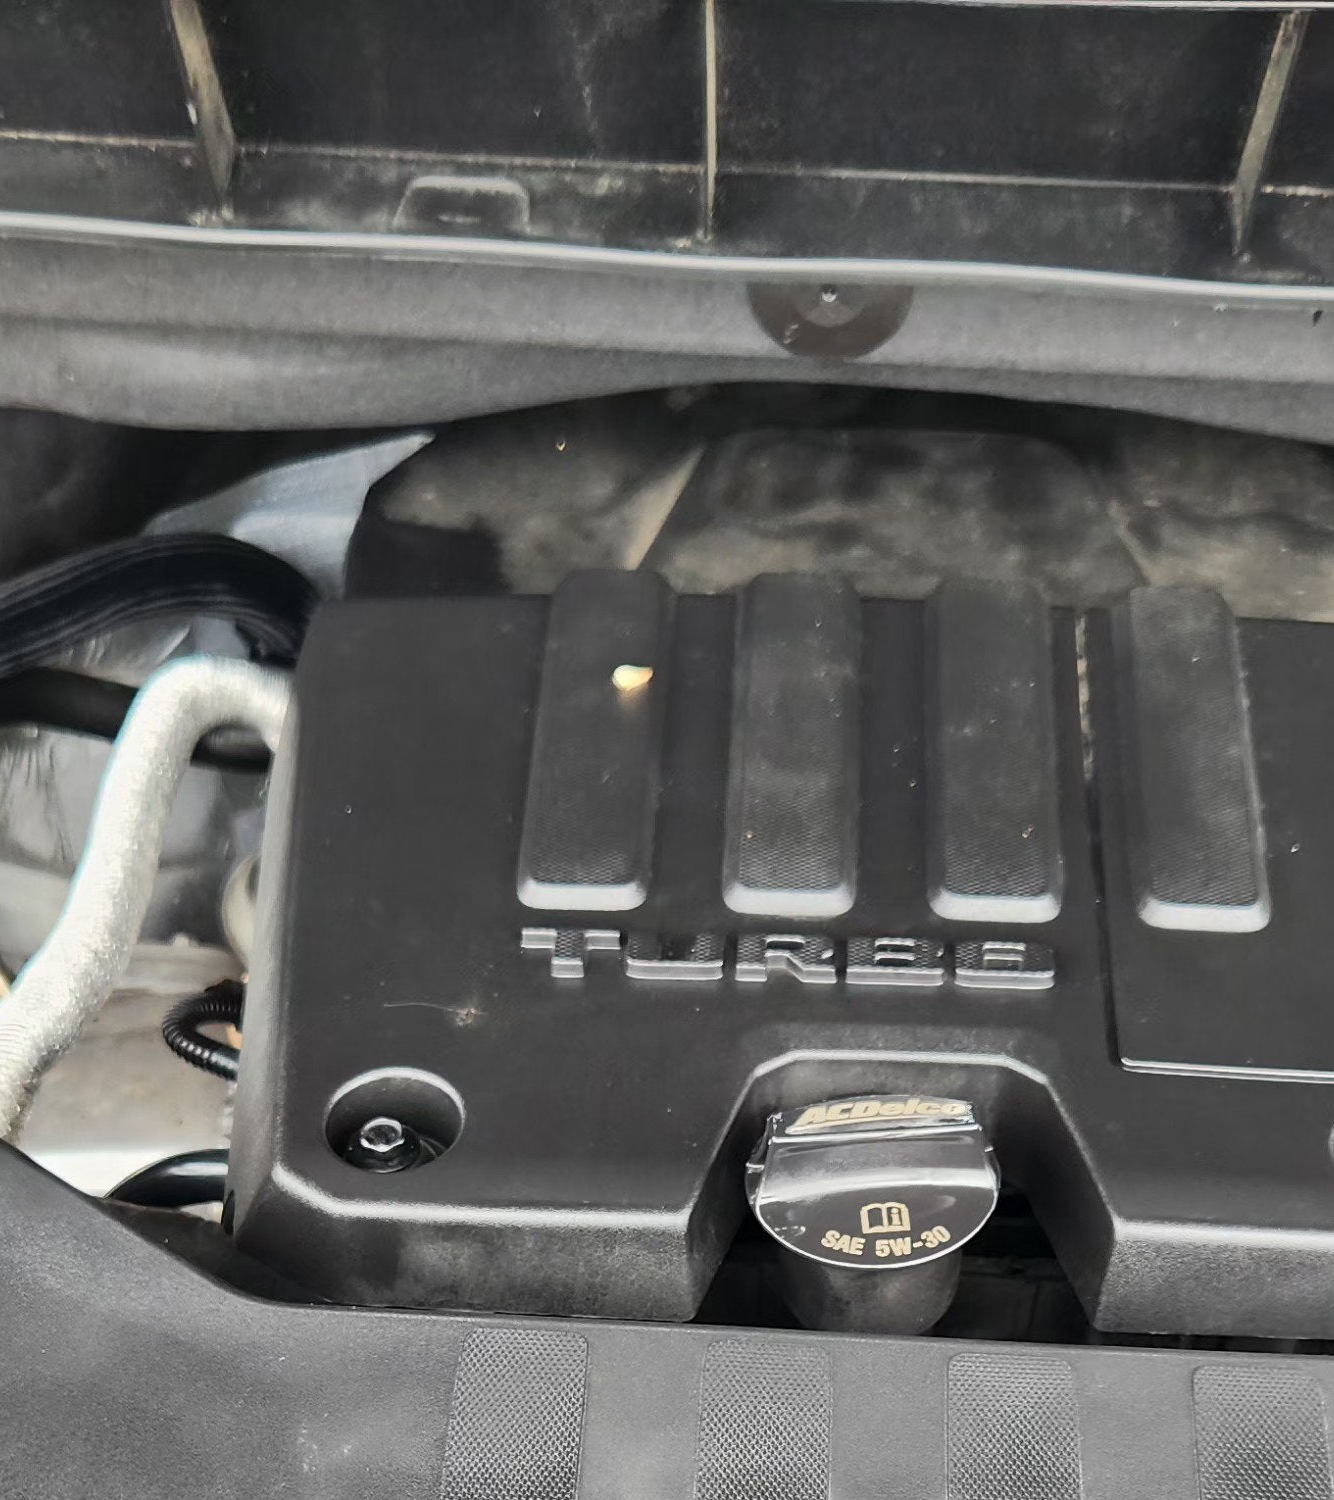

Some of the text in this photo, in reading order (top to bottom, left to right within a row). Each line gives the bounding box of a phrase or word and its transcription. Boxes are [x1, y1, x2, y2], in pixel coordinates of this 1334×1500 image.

[521, 927, 1055, 988] TURBO
[798, 1098, 972, 1126] ACDelco
[821, 1225, 951, 1258] SAE 5W-30
